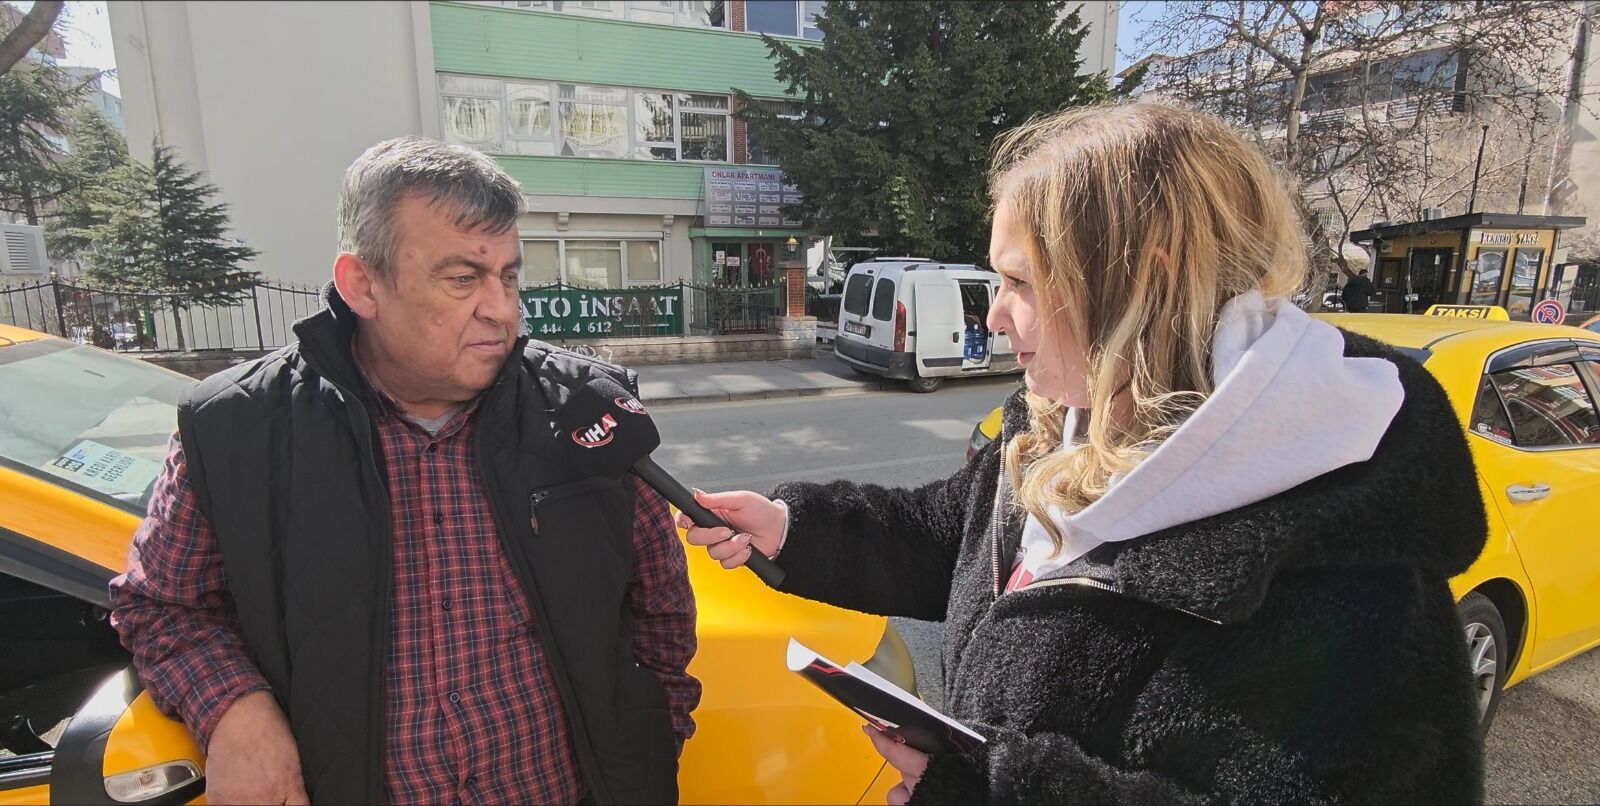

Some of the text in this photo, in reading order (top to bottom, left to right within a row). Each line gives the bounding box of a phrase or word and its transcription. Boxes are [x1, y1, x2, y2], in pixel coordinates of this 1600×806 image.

[712, 171, 735, 179] ONLAR
[737, 172, 776, 180] APARTMANI
[572, 322, 581, 333] 4
[587, 321, 612, 333] 612
